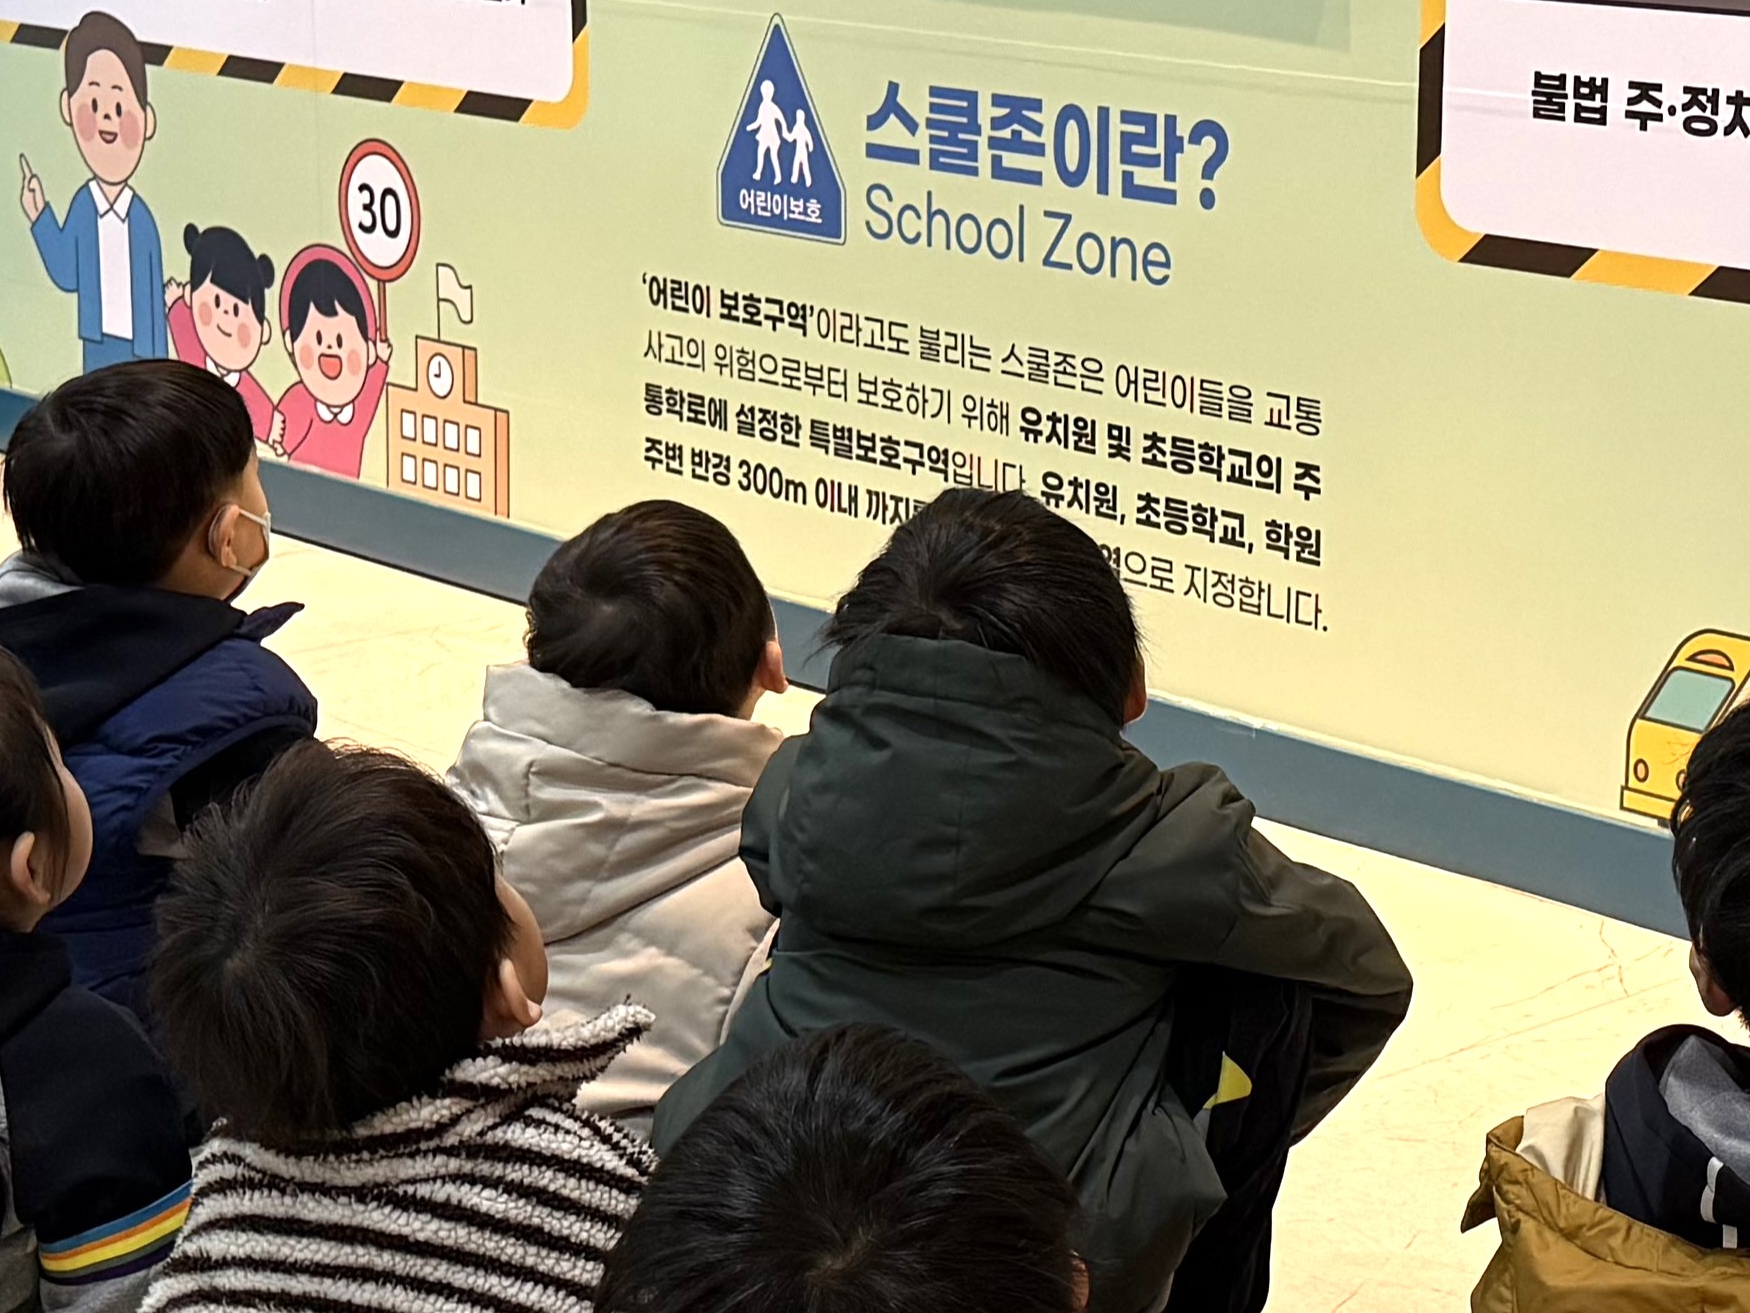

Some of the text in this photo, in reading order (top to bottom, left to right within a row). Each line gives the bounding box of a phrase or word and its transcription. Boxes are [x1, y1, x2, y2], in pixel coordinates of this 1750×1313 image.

[865, 80, 1230, 210] 스쿨존이란?
[1531, 70, 1610, 125] 불법
[357, 182, 402, 239] 30
[738, 188, 824, 225] 어린이보호
[865, 182, 1172, 286] School Zone
[643, 328, 1322, 501] 사고의 위험으로부터 보호하기 위해 유치원 및 초등학교의 주
[918, 325, 993, 374] 불리는
[1000, 342, 1105, 396] 스쿨존은
[1114, 363, 1255, 425] 어린이들을
[1263, 391, 1323, 437] 교통
[643, 382, 729, 432] 통학로에
[735, 403, 802, 448] 설정한
[1039, 470, 1127, 525] 유치원,
[1135, 491, 1255, 554] 초등학교,
[1263, 518, 1322, 567] 학원
[643, 436, 684, 476] 주변
[690, 447, 731, 487] 반경
[737, 459, 808, 506] 300m
[814, 477, 859, 519] 이내
[1183, 563, 1329, 632] 지정합니다.
